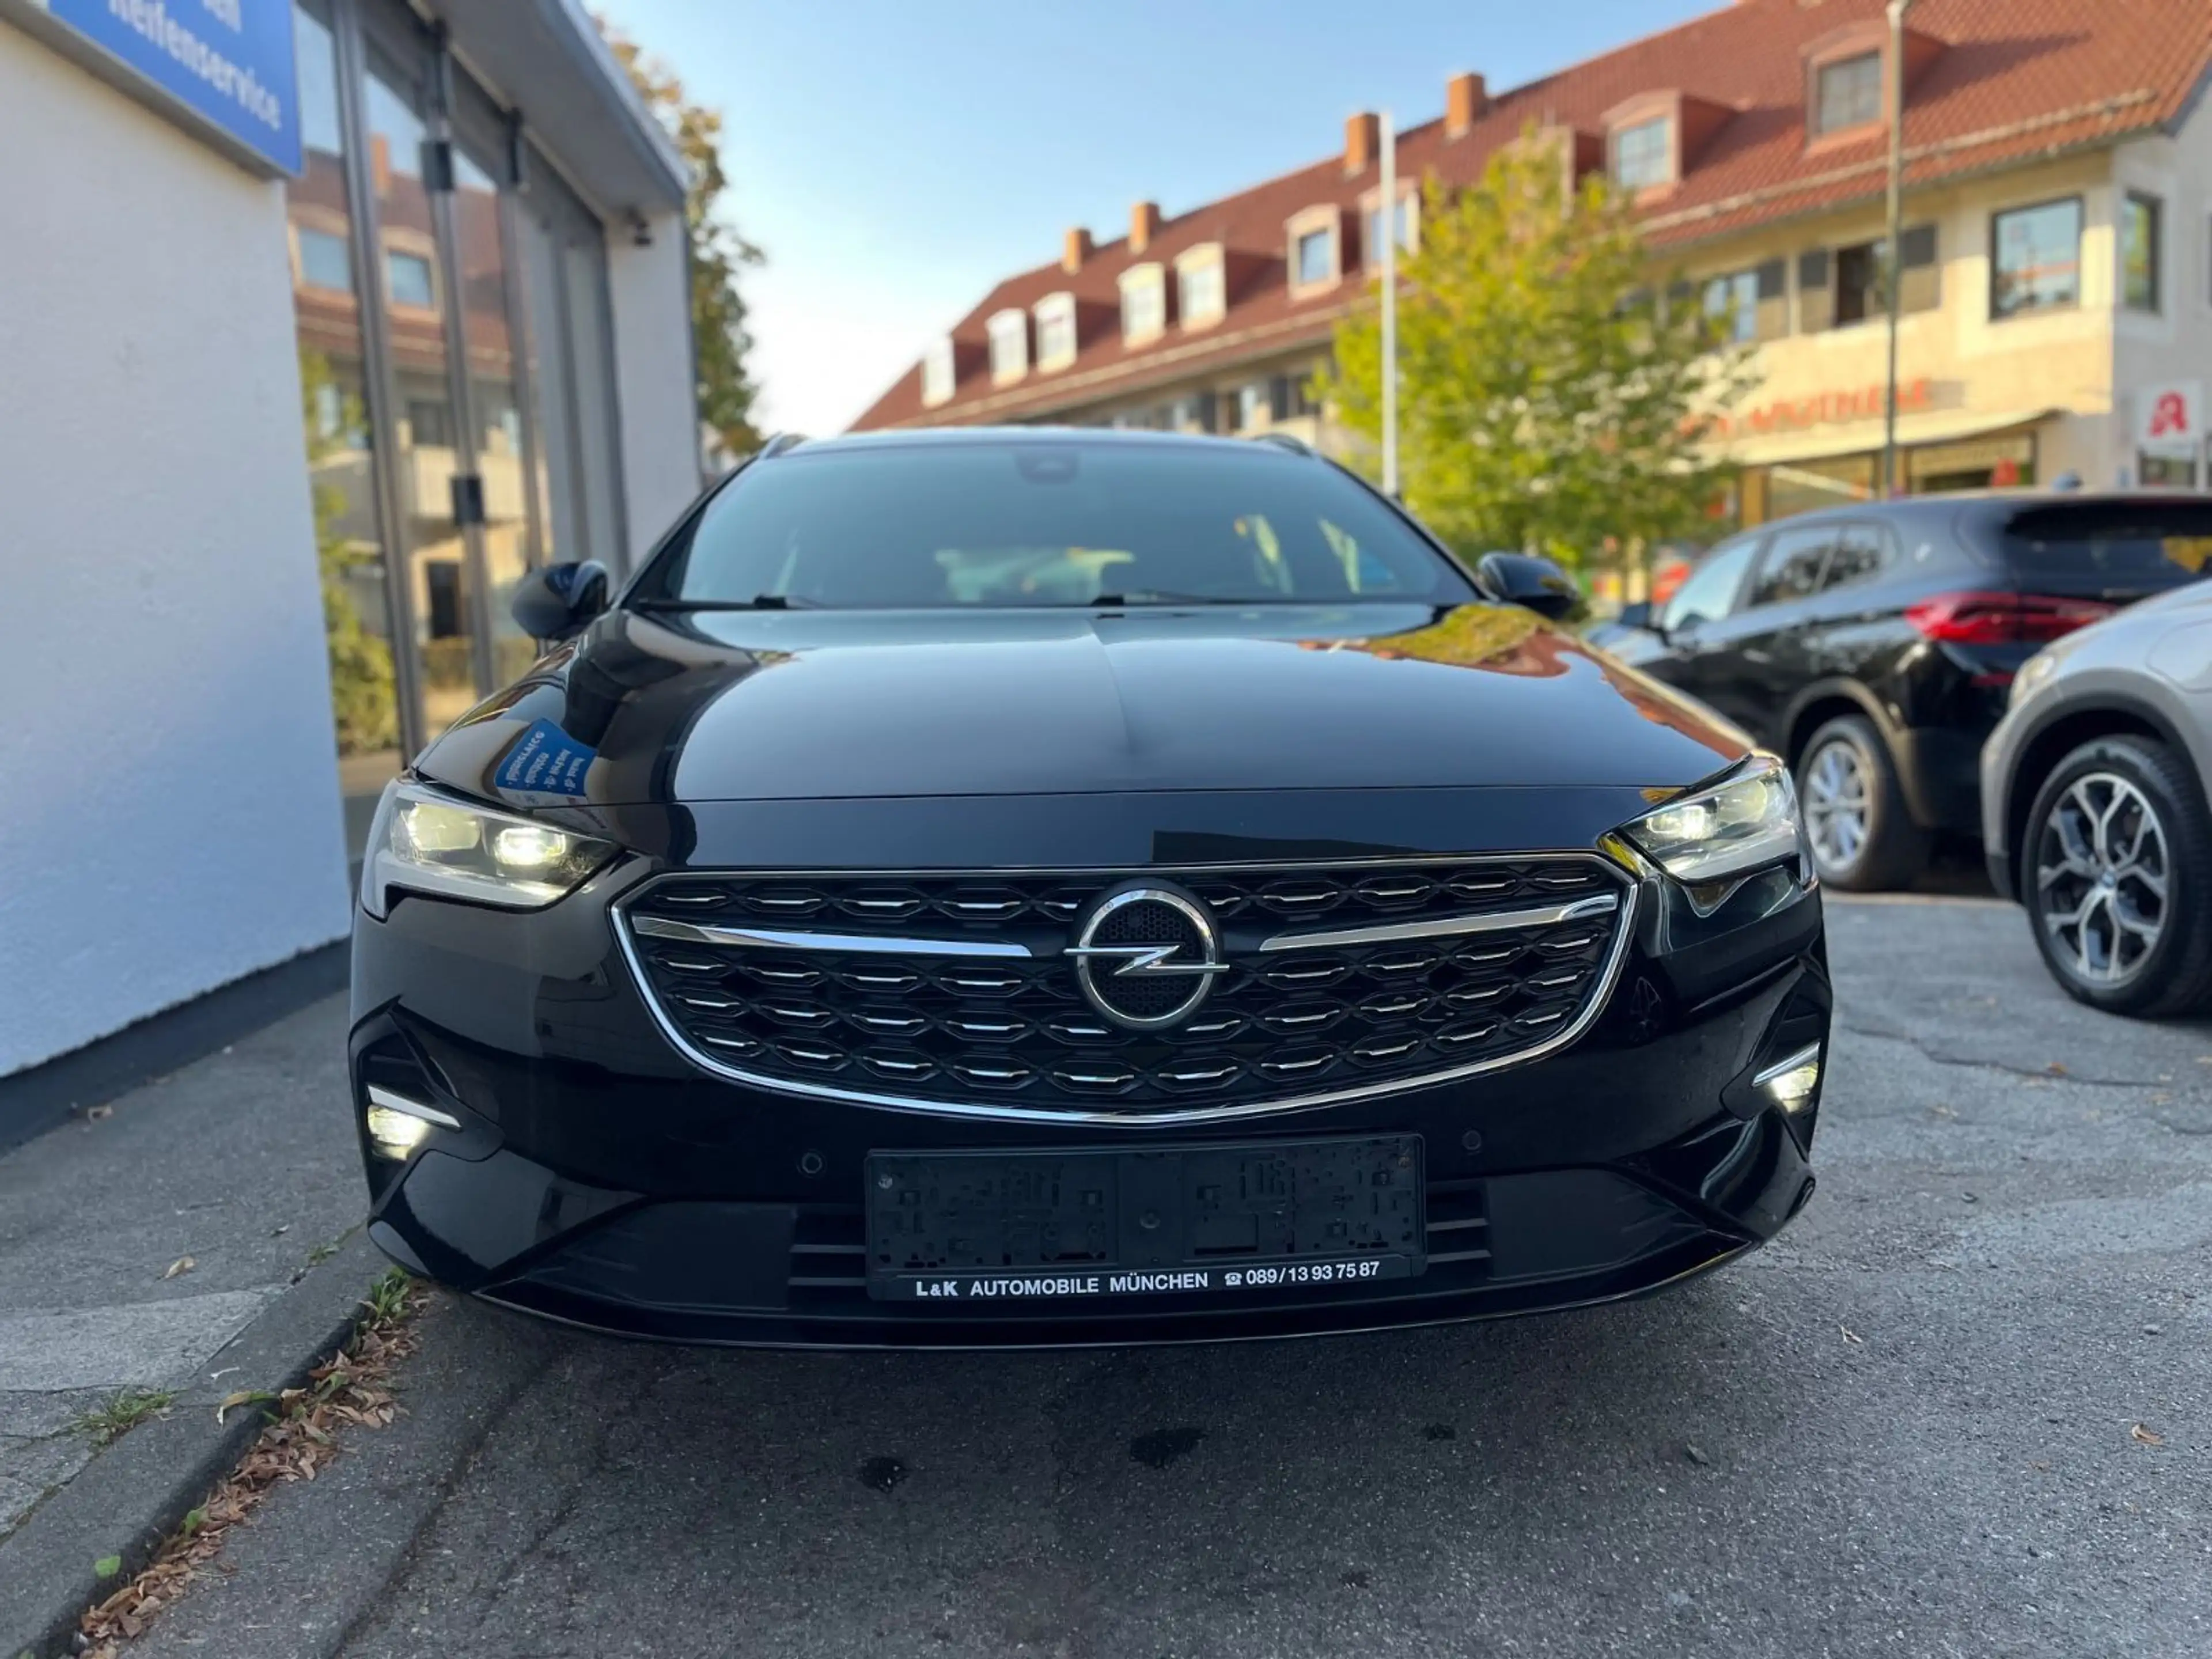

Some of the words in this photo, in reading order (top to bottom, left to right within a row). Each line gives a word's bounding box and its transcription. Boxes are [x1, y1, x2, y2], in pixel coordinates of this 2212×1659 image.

[916, 1281, 959, 1297] L&K
[970, 1277, 1099, 1296] AUTOMOBILE
[1109, 1271, 1209, 1293] MÜNCHEN
